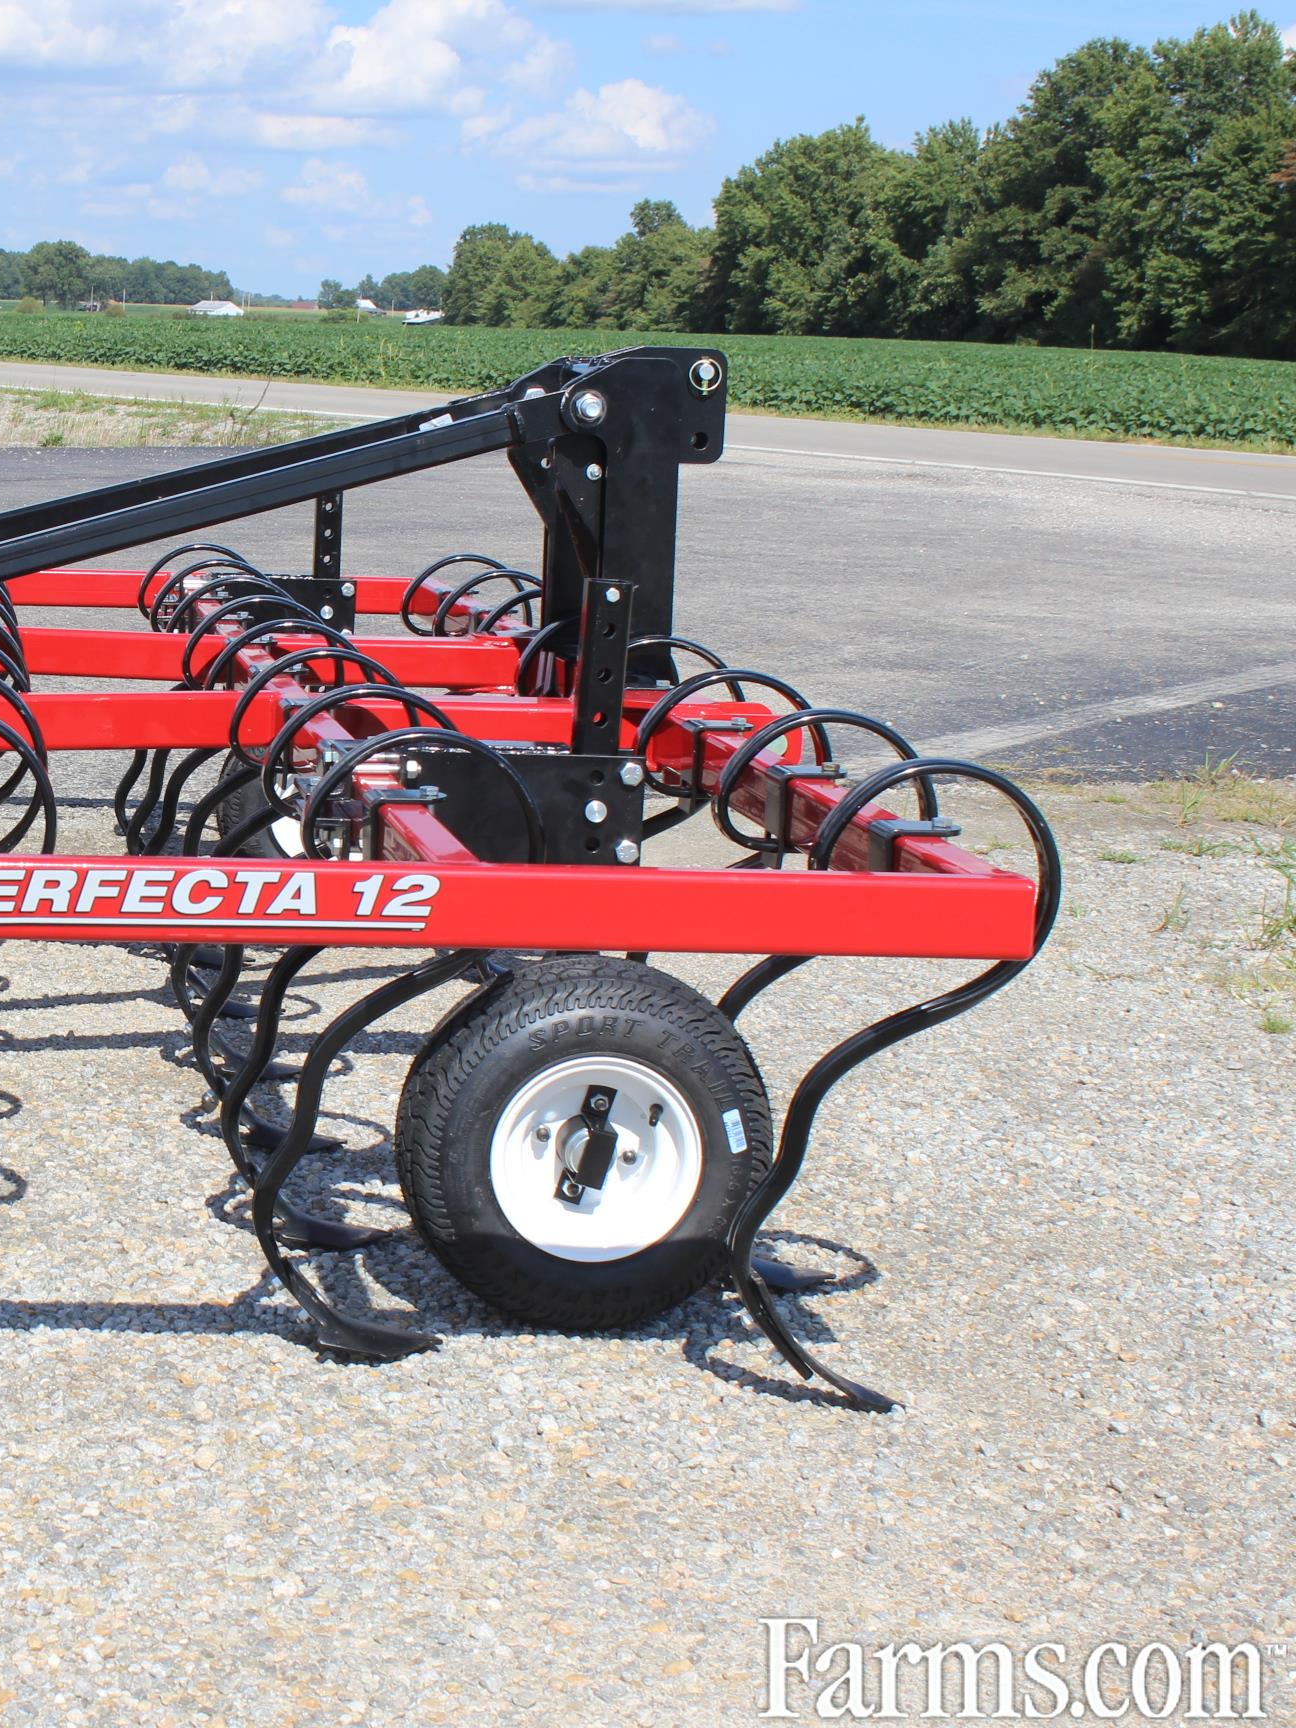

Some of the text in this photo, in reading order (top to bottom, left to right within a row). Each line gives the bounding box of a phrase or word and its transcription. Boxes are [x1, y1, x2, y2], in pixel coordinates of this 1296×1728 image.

[353, 874, 441, 917] 12
[528, 1015, 736, 1110] SPORT TRAIL
